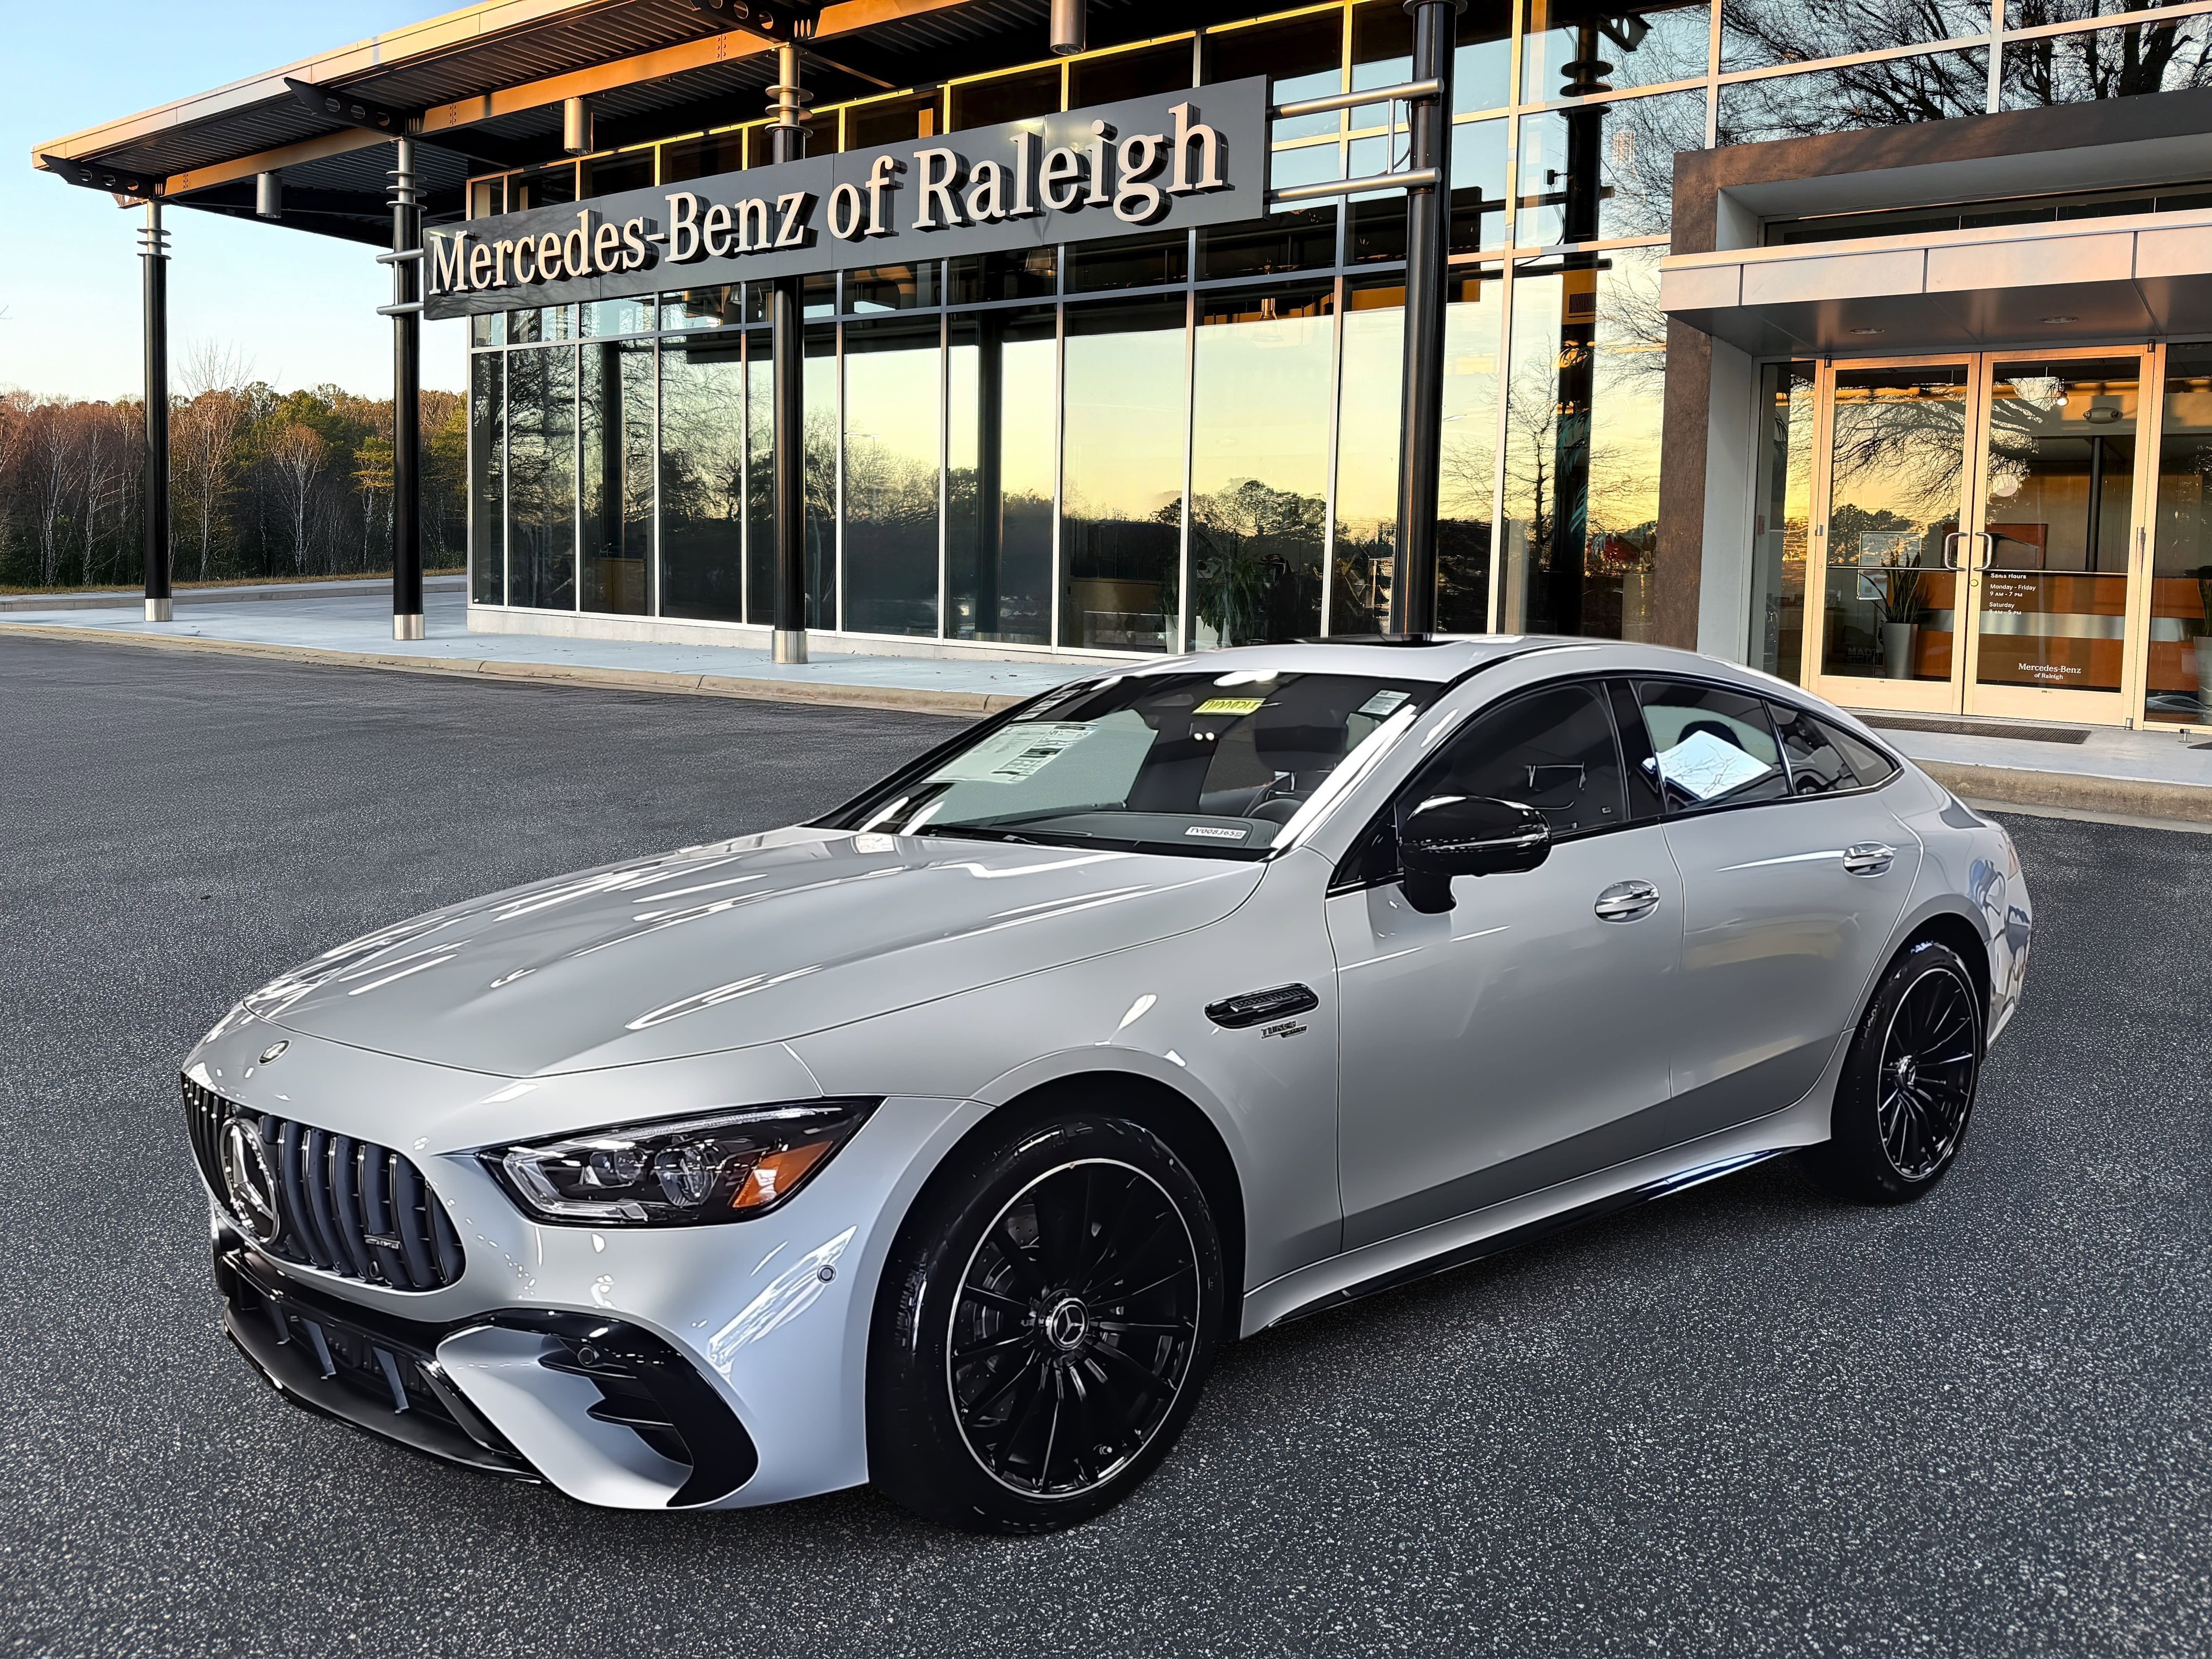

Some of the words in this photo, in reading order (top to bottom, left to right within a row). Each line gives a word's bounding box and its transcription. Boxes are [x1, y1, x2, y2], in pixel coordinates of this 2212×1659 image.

[429, 191, 806, 295] Mercedes-Benz
[827, 155, 894, 239] of
[912, 101, 1223, 223] Raleigh
[2018, 663, 2081, 673] Mercedes-Benz
